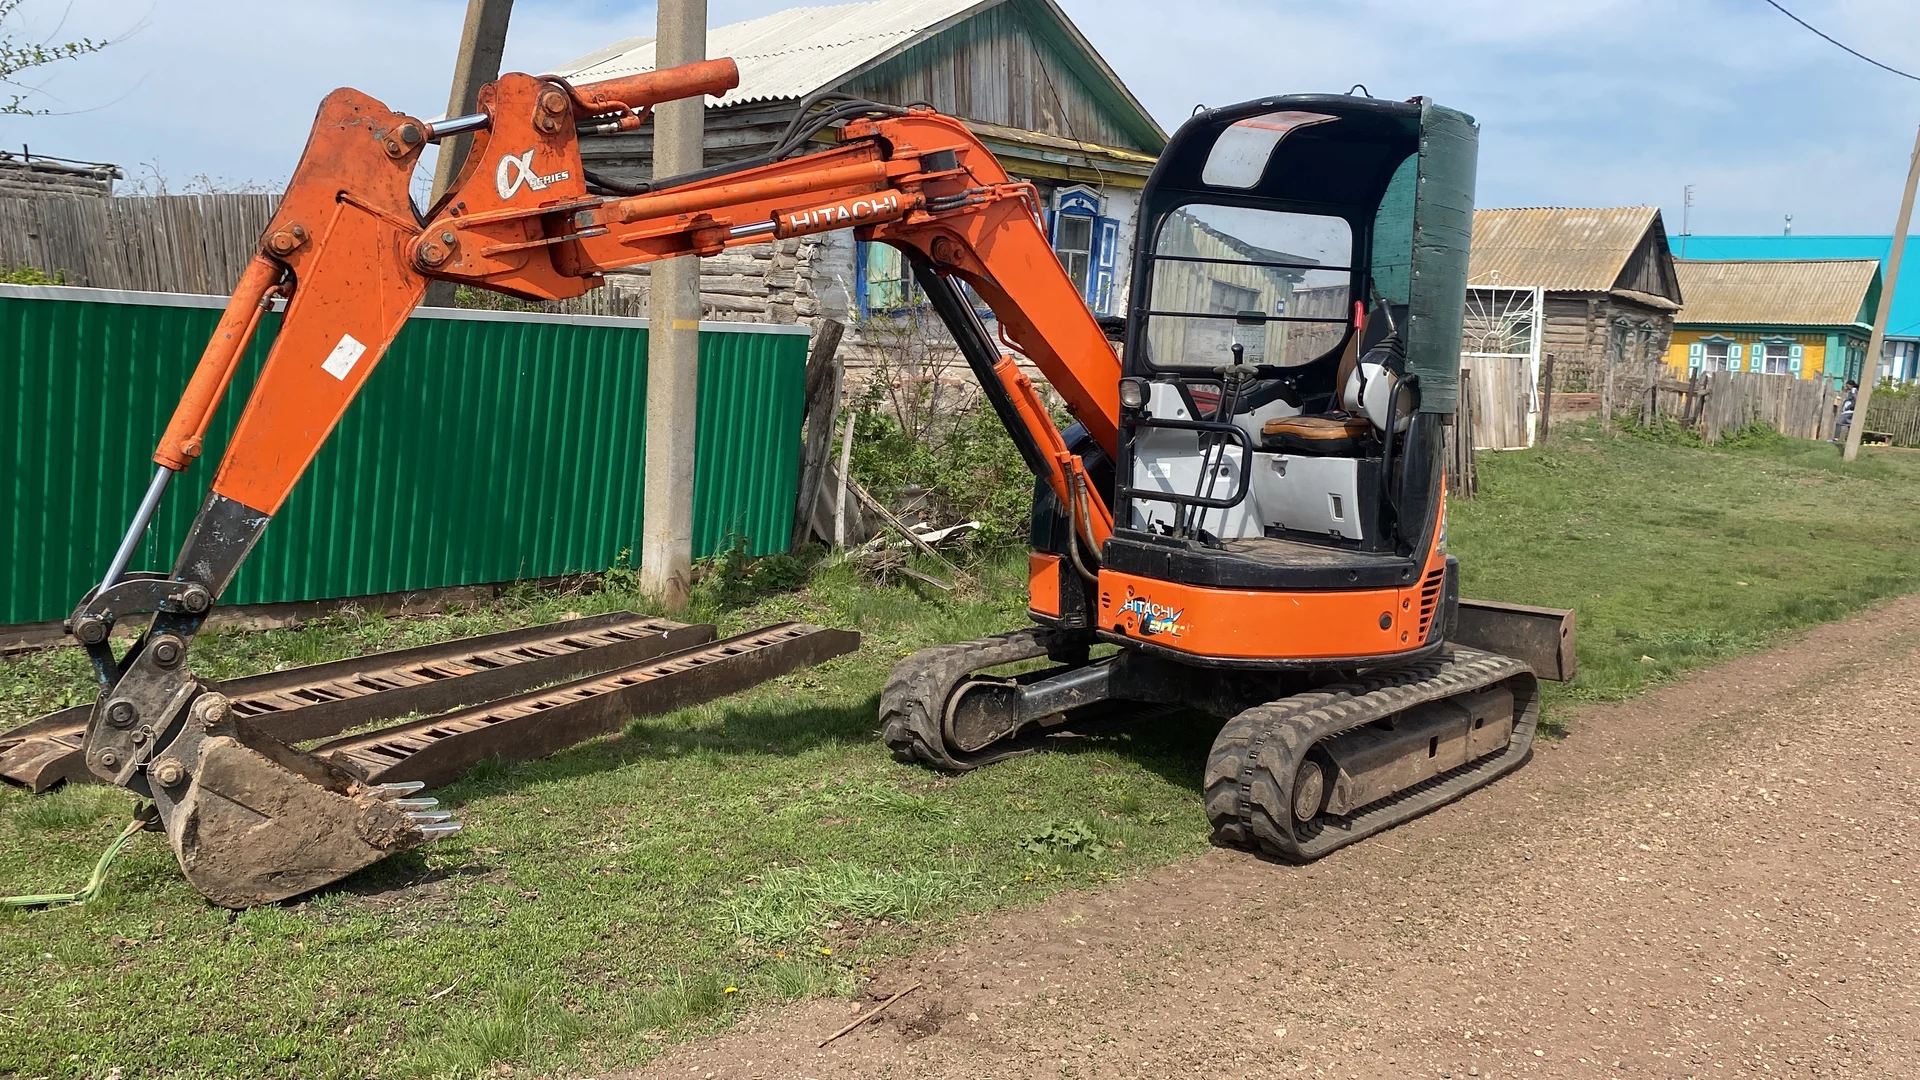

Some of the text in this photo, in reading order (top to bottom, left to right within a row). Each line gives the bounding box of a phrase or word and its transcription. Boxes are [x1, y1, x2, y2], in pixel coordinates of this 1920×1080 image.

[530, 171, 570, 187] SERIES
[789, 195, 898, 232] HITACHI
[1124, 599, 1174, 619] HITACHI
